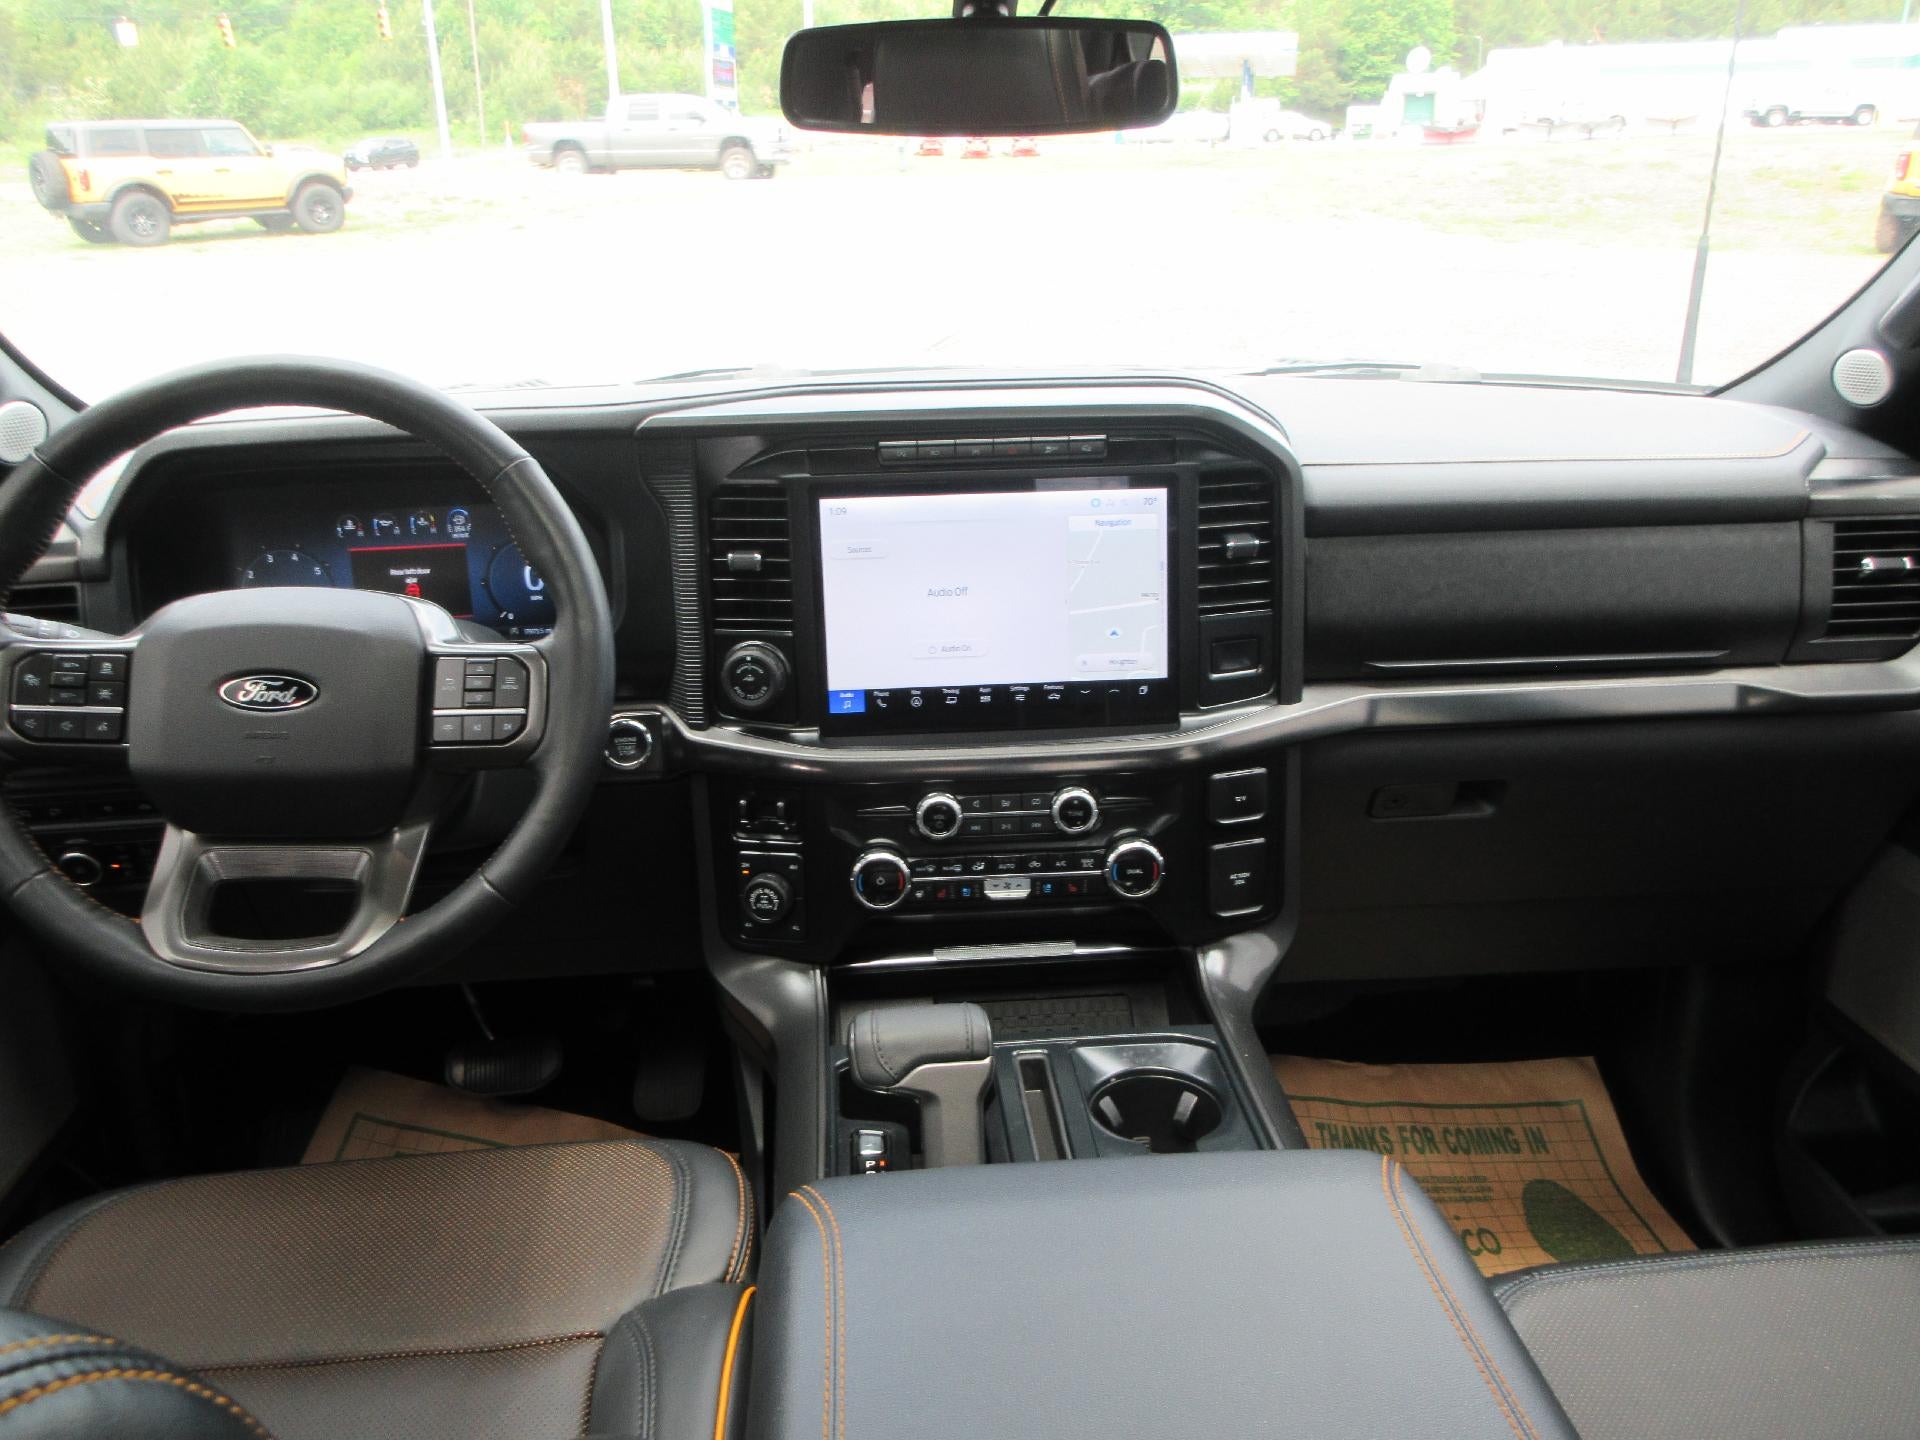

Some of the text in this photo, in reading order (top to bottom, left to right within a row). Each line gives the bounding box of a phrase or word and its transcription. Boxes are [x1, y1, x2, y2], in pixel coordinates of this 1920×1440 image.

[266, 553, 274, 563] 3
[290, 553, 299, 562] 4
[247, 570, 255, 579] 2
[313, 566, 322, 575] 5
[927, 586, 969, 598] Audio Off
[941, 645, 960, 653] Audio
[237, 679, 296, 705] Ford
[1315, 1122, 1550, 1155] THANKS FOR COMING IN
[865, 1160, 876, 1168] P
